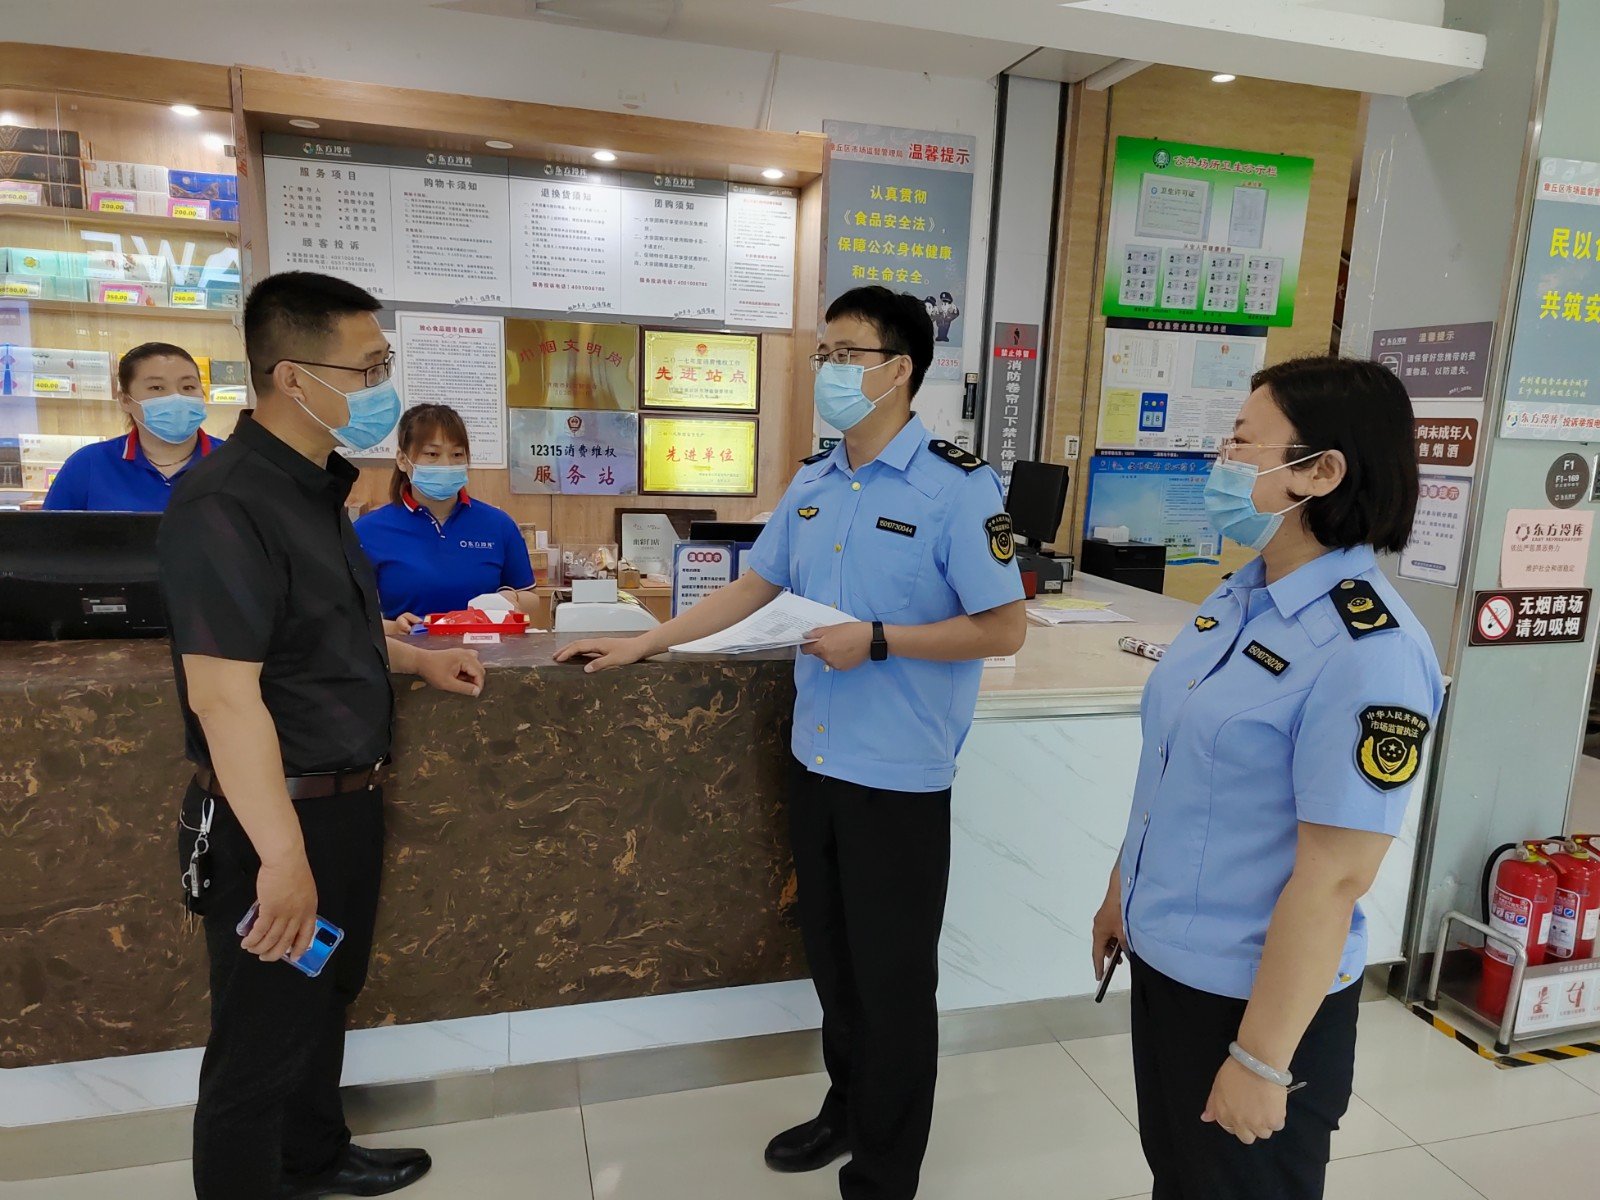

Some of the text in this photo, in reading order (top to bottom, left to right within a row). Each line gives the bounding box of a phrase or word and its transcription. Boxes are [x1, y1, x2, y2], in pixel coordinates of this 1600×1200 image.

[909, 143, 970, 165] 温馨提示
[1174, 154, 1278, 177] 公共场所卫生公示栏
[300, 166, 356, 181] 服务项目
[424, 177, 477, 191] 购物卡须知
[541, 188, 591, 201] 退换货须知
[870, 185, 928, 205] 认真贯彻
[654, 198, 695, 211] 团购须知
[302, 237, 360, 251] 顾客投诉
[837, 236, 954, 260] 保障公众身体健康
[852, 265, 931, 286] 和生命安全。
[419, 324, 484, 335] 放心食品超市自我承诺
[1418, 330, 1455, 344] 温馨提示
[520, 338, 623, 368] 巾帼文明岗
[1001, 348, 1031, 358] 禁止停留
[1407, 351, 1477, 364] 请保管好您携带的贵
[937, 358, 960, 369] 12315
[655, 366, 748, 384] 先进站点
[1521, 412, 1558, 424] 东方冷库
[1414, 425, 1473, 441] 向未成年人
[666, 445, 735, 462] 先进单位
[1563, 460, 1575, 471] F1
[533, 465, 616, 486] 服务站
[1534, 523, 1584, 536] 东方冷库
[1519, 595, 1585, 616] 无烟商场
[1515, 617, 1580, 638] 请勿吸烟
[1366, 710, 1427, 731] 中华人民共和国
